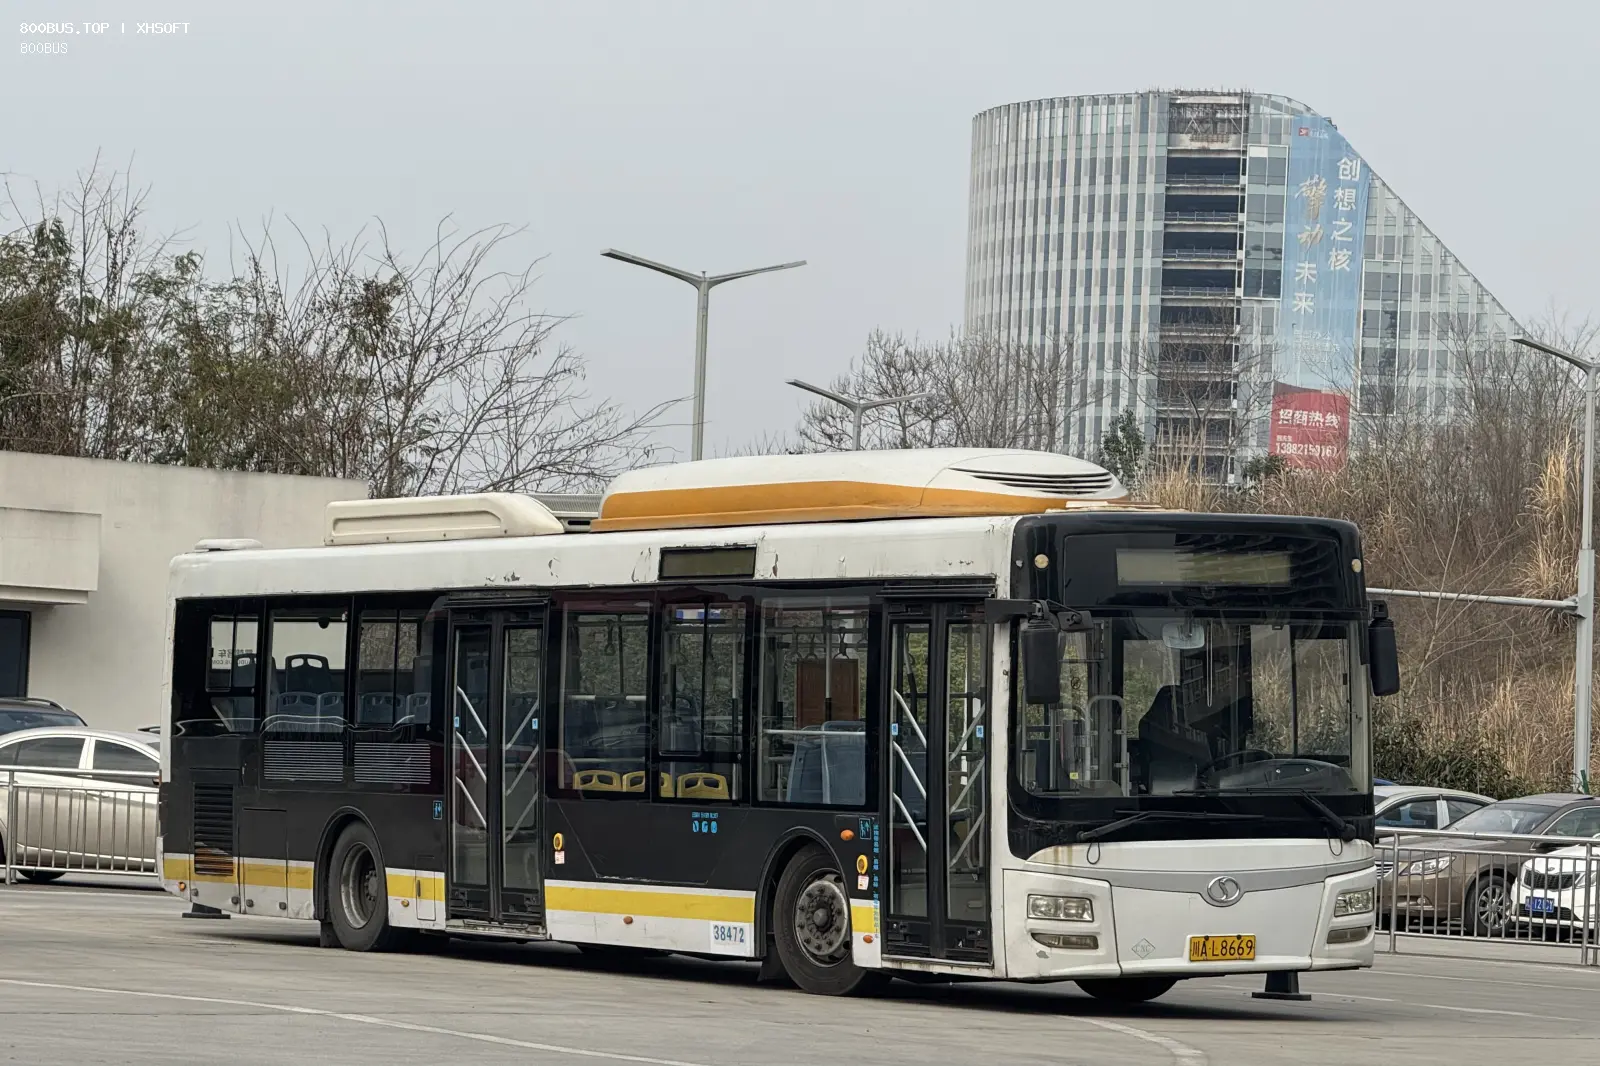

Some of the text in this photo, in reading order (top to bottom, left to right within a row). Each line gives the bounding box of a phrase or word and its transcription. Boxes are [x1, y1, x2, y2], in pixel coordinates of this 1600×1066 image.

[1327, 157, 1361, 272] 创想之核
[1278, 408, 1341, 428] 招商热线
[713, 924, 745, 943] 38472
